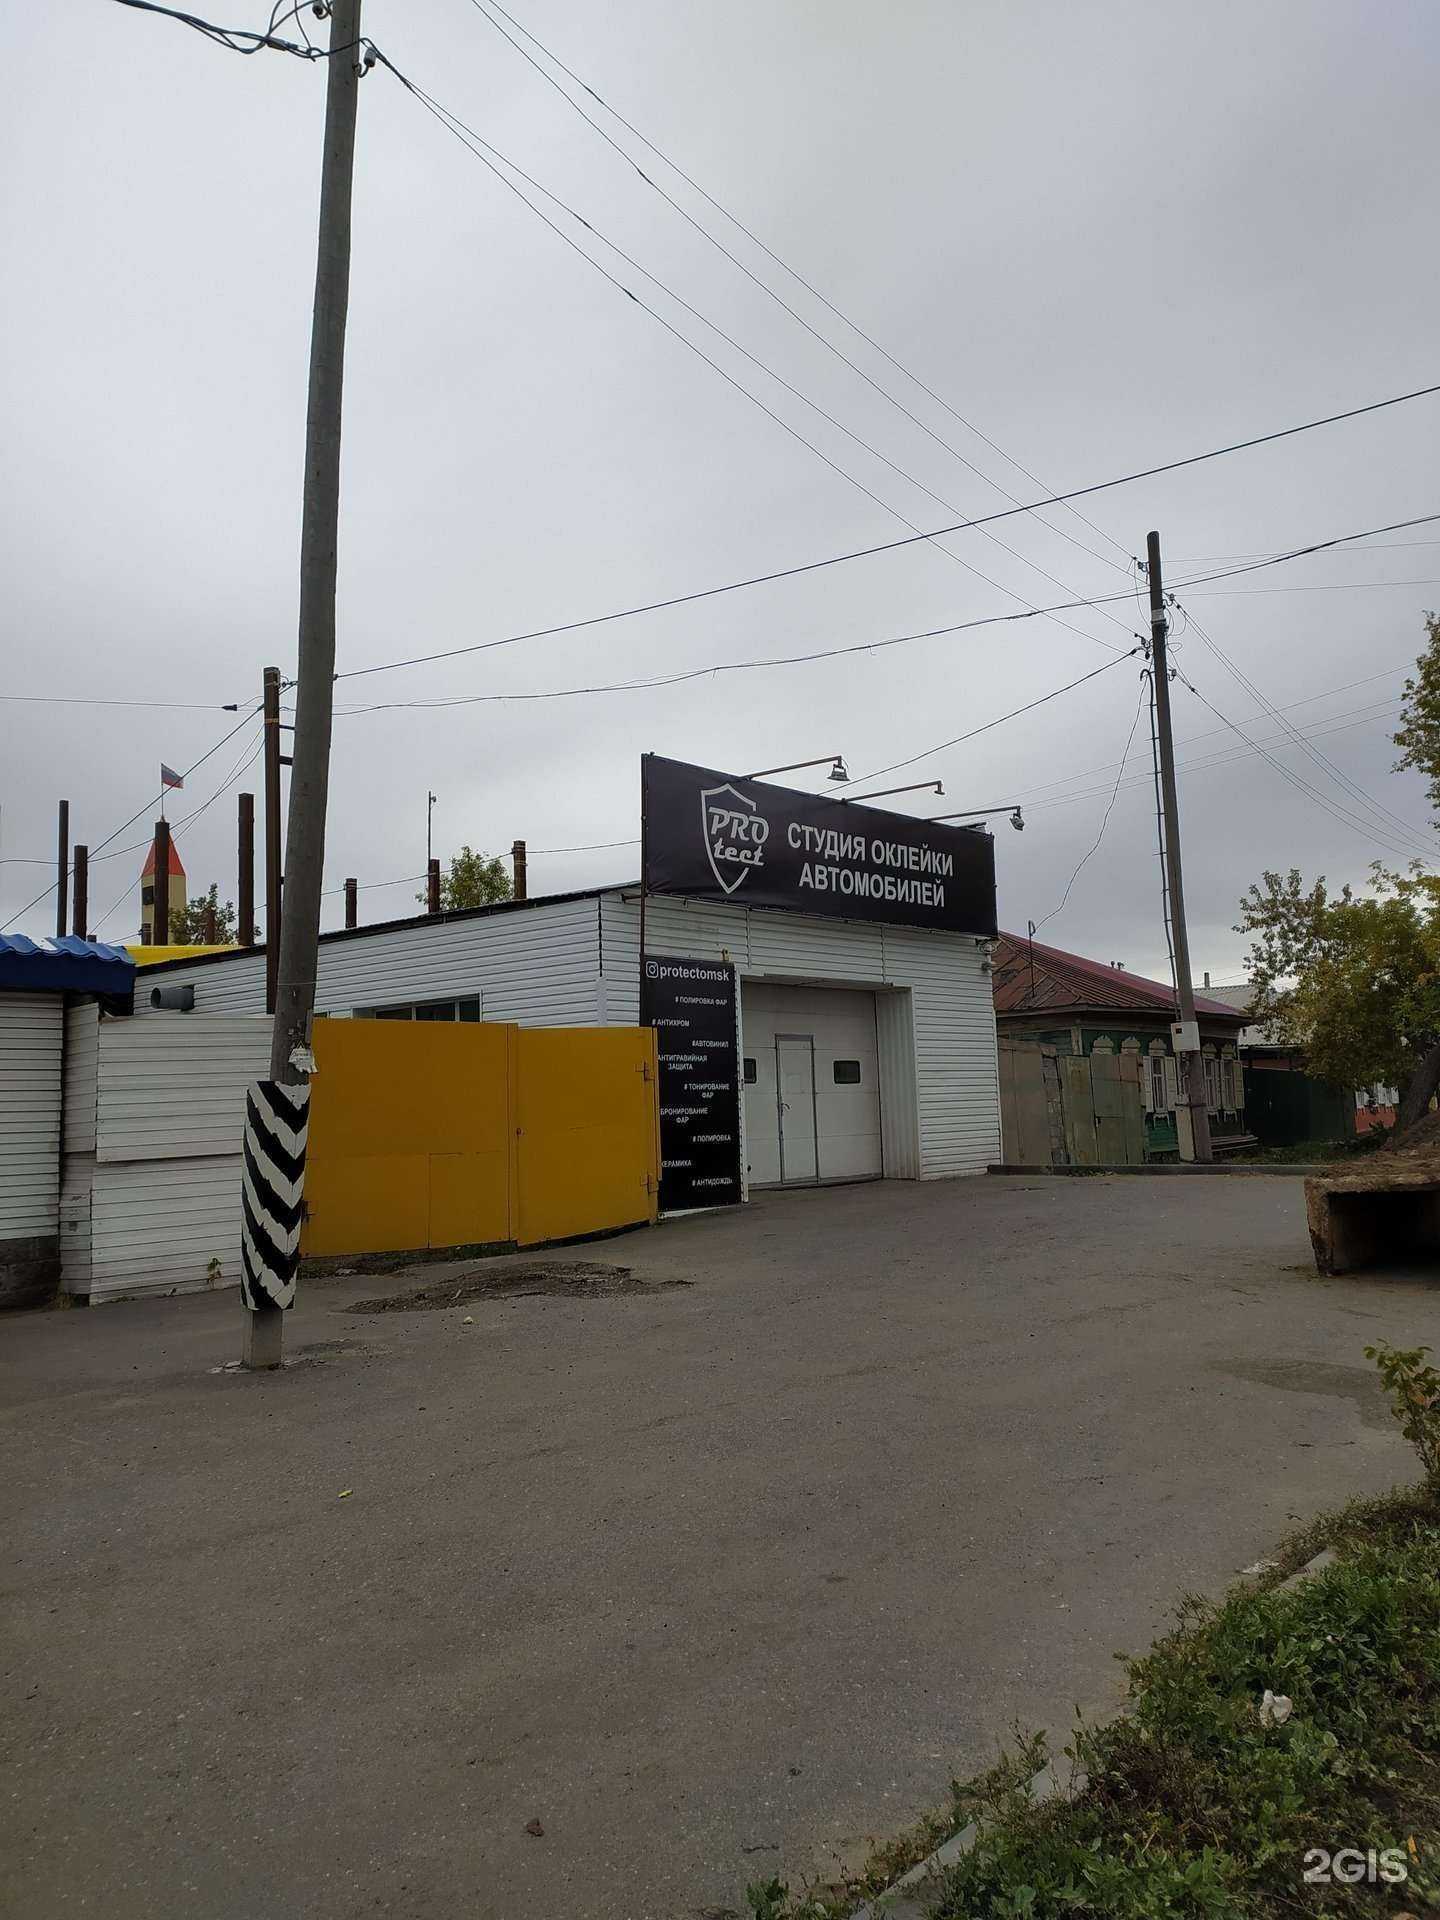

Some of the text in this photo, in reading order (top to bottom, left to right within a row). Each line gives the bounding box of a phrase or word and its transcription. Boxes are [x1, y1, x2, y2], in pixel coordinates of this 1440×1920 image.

[708, 806, 769, 844] PRO
[711, 838, 765, 867] tect
[787, 822, 954, 877] СТУДИЯ ОКЛЕЙКИ
[799, 862, 946, 908] АВТОМОБИЛЕЙ
[660, 966, 729, 981] protectomsk
[657, 1018, 690, 1027] АНТИХРОМ
[668, 1063, 693, 1071] ЗАЩИТА
[660, 1107, 709, 1116] БРОНИРОВАНИЕ
